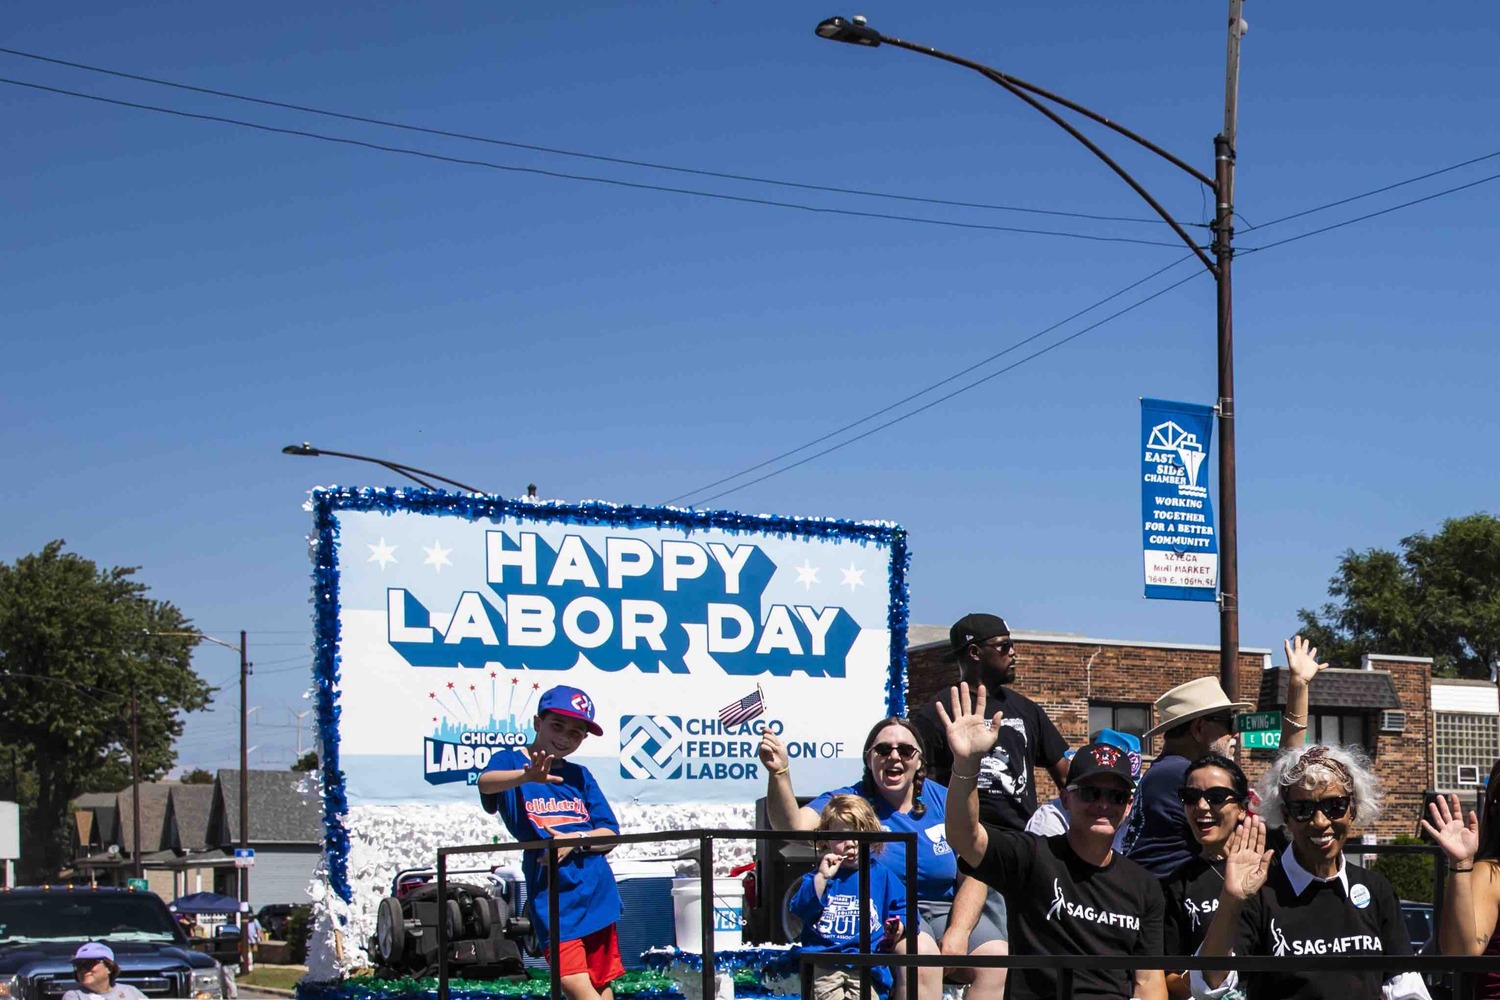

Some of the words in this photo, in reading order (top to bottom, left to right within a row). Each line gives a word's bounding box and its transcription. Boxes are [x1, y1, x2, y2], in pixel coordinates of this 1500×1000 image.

[1145, 452, 1175, 464] EAST
[1156, 465, 1185, 476] SIDE
[1144, 474, 1186, 485] CHAMBER
[1155, 497, 1202, 509] WORKING
[1153, 510, 1205, 522] TOGETHER
[1145, 522, 1165, 531] FOR
[1167, 523, 1175, 532] A
[1177, 524, 1213, 535] BETTER
[1149, 535, 1210, 547] COMMUNITY
[485, 530, 756, 595] HAPPY
[1175, 565, 1210, 574] MARKET
[387, 587, 668, 652] LABOR
[706, 603, 845, 657] DAY
[1246, 714, 1269, 730] EWING
[460, 732, 527, 746] CHICAGO
[1250, 734, 1255, 743] E
[686, 741, 817, 758] FEDERON
[820, 742, 844, 758] OF
[426, 740, 500, 774] LABO
[686, 763, 758, 779] LABOR
